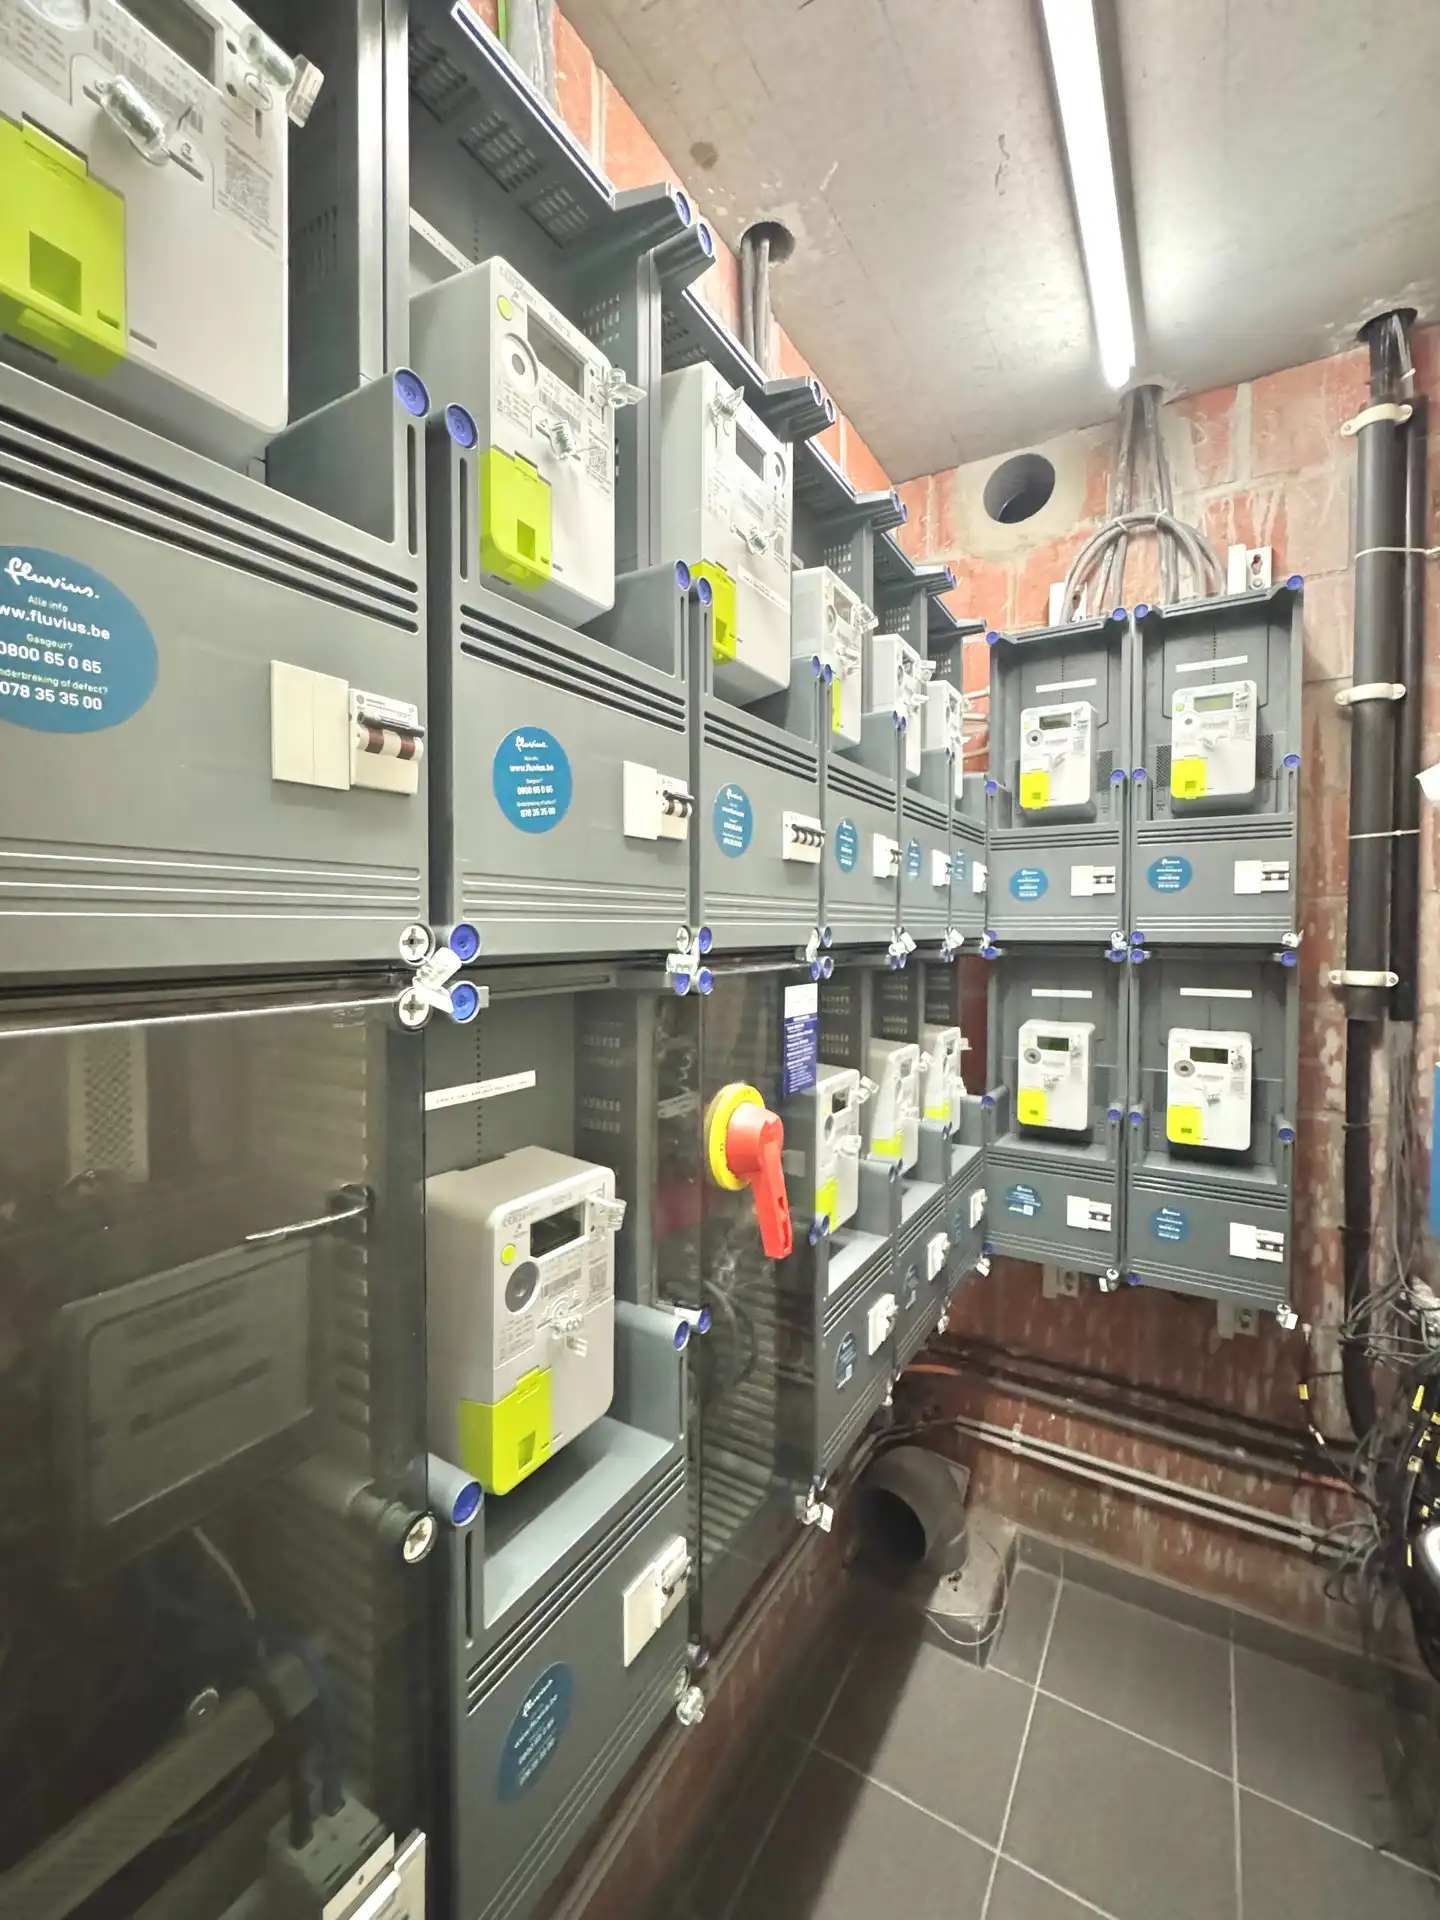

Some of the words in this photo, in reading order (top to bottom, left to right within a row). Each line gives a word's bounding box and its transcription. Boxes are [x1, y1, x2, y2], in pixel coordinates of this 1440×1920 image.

[28, 595, 47, 608] Alle
[49, 600, 68, 613] info
[26, 633, 73, 650] Gasgeur?
[44, 651, 65, 667] 65
[68, 656, 79, 670] 0
[82, 660, 102, 674] 65
[0, 681, 30, 698] 078
[35, 687, 56, 703] 35
[59, 691, 79, 706] 35
[82, 695, 103, 710] 00
[60, 679, 72, 689] of
[72, 682, 109, 695] defect?
